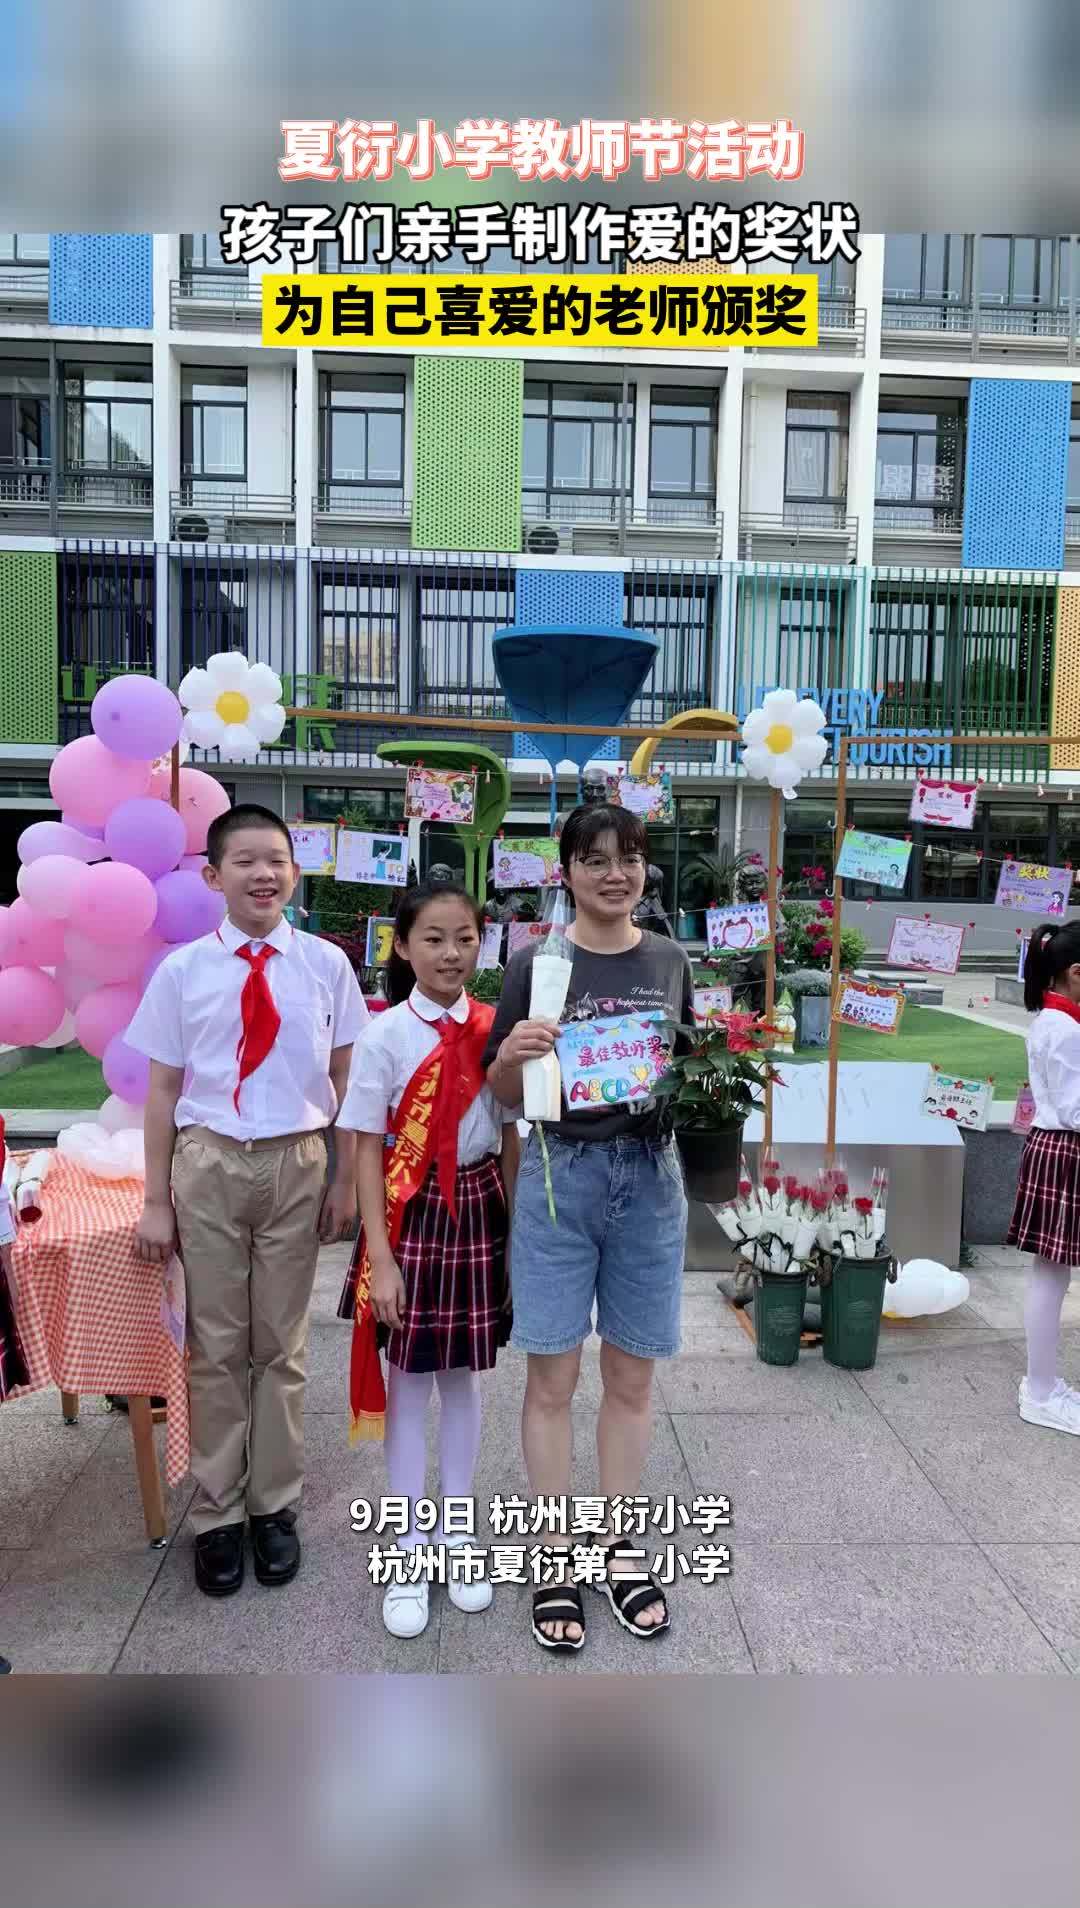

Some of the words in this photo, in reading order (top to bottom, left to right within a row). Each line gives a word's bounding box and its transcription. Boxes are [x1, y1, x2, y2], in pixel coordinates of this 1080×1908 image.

[638, 987, 654, 996] had
[577, 1035, 662, 1068] 最佳教师奖
[569, 1078, 632, 1104] ABCD
